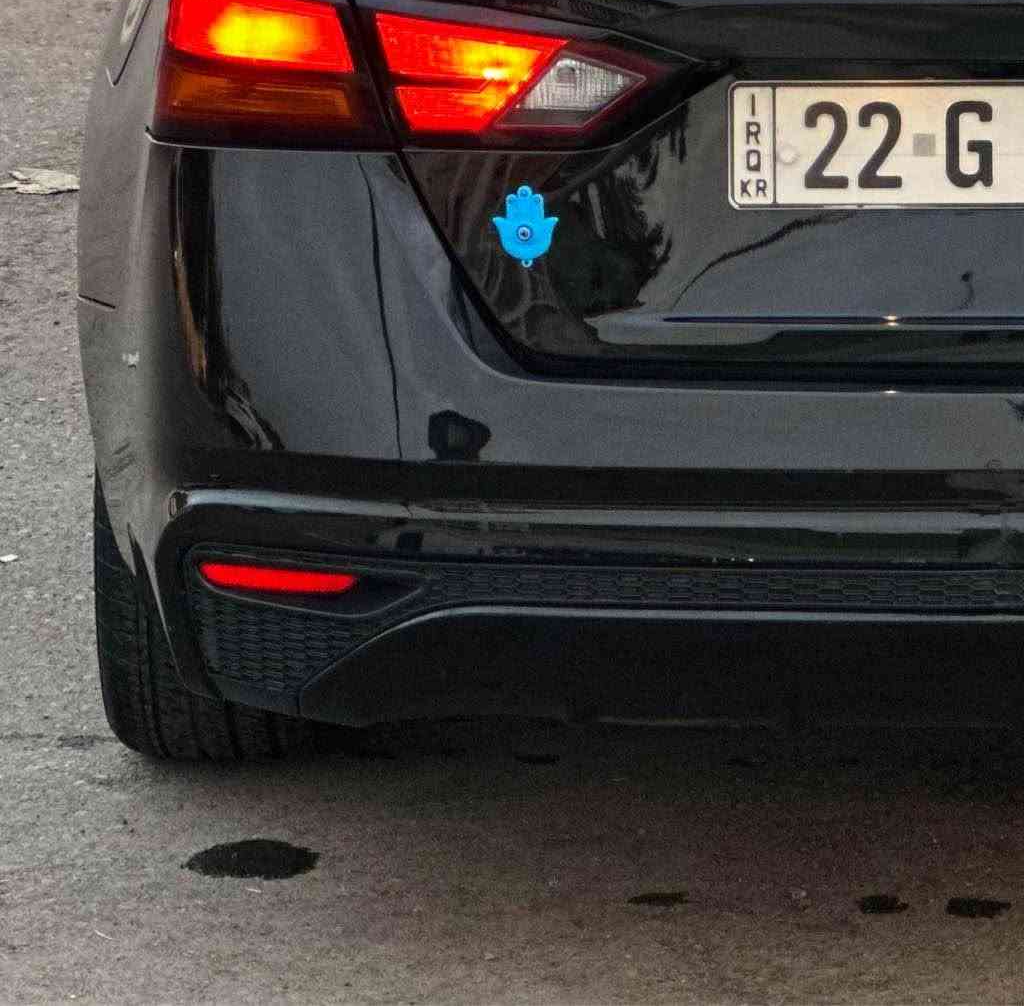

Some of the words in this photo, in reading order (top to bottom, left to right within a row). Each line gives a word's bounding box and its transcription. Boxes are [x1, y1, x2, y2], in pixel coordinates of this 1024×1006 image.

[804, 101, 903, 189] 22
[945, 101, 994, 189] G
[740, 179, 767, 197] KR
